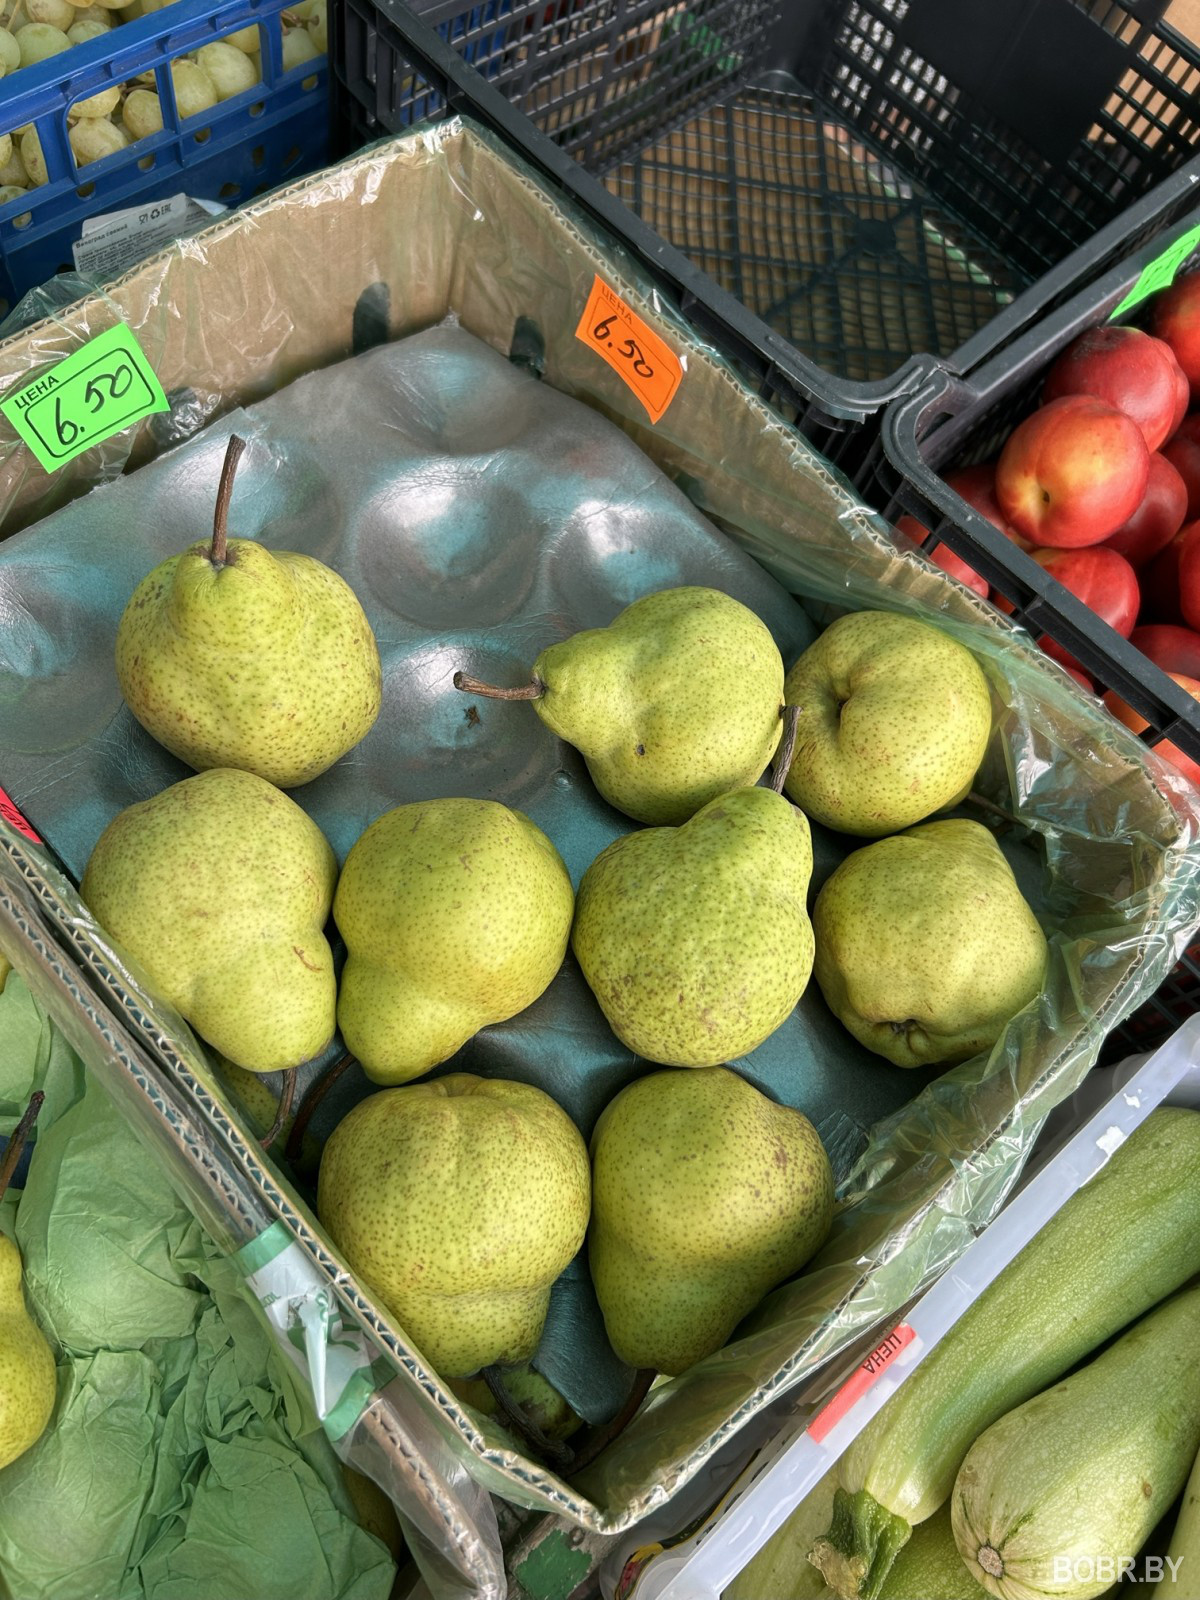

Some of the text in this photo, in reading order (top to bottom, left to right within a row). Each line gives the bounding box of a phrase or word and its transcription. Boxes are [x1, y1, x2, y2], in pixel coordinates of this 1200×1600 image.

[602, 285, 633, 325] ЦЕНА
[593, 315, 654, 379] 6.50
[14, 375, 60, 410] ЦЕНА
[862, 1332, 902, 1374] ЦЕНА
